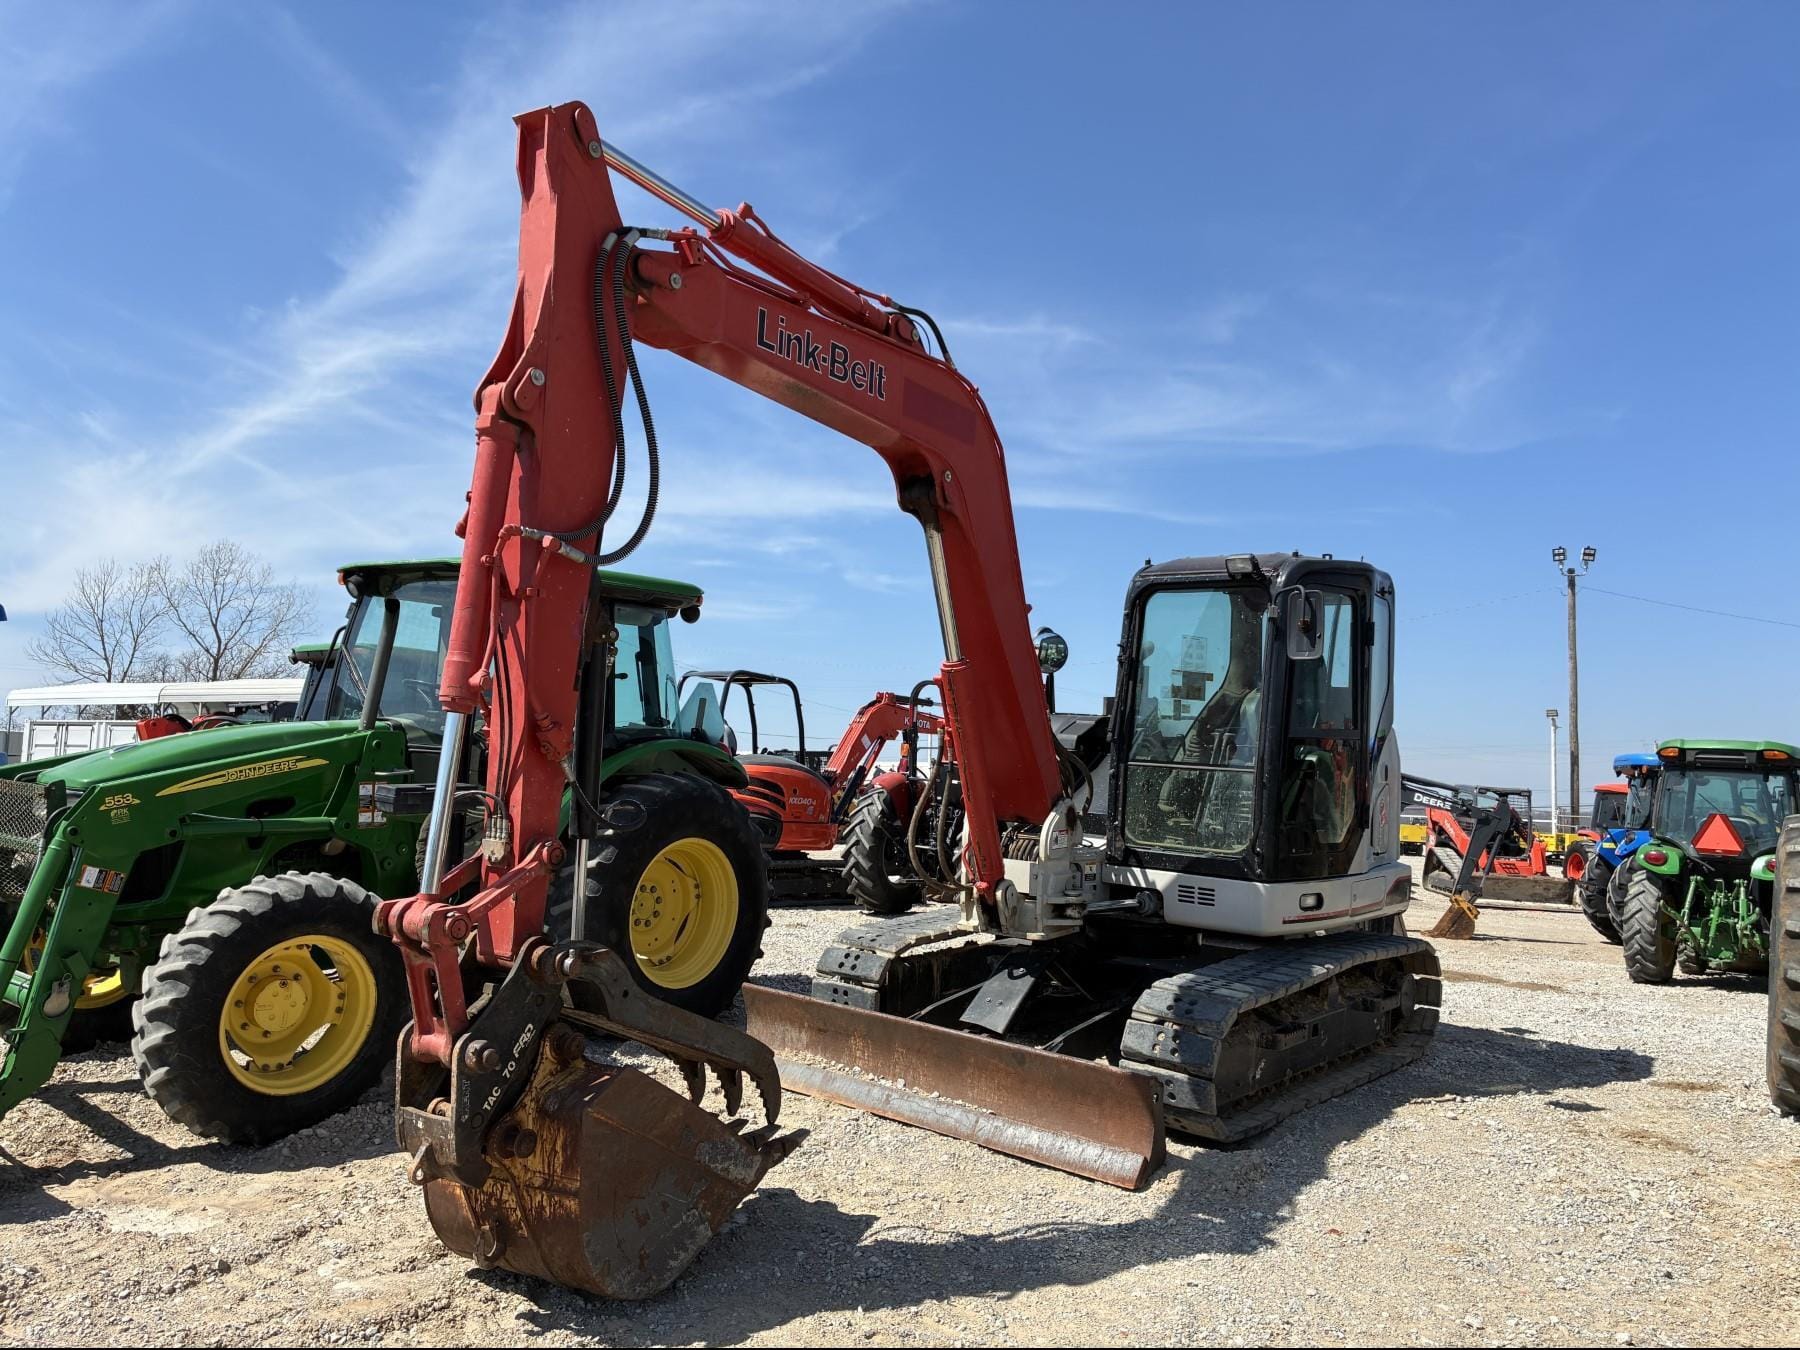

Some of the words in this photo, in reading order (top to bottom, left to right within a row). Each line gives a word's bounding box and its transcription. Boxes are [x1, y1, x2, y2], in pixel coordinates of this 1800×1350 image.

[756, 306, 886, 401] Link-Belt
[904, 716, 930, 729] KOTA
[224, 766, 255, 781] JOHN
[255, 760, 297, 776] DEERE
[105, 793, 133, 807] 553
[1413, 792, 1452, 810] DEERE
[482, 1086, 501, 1111] TAC
[502, 1061, 516, 1079] 70
